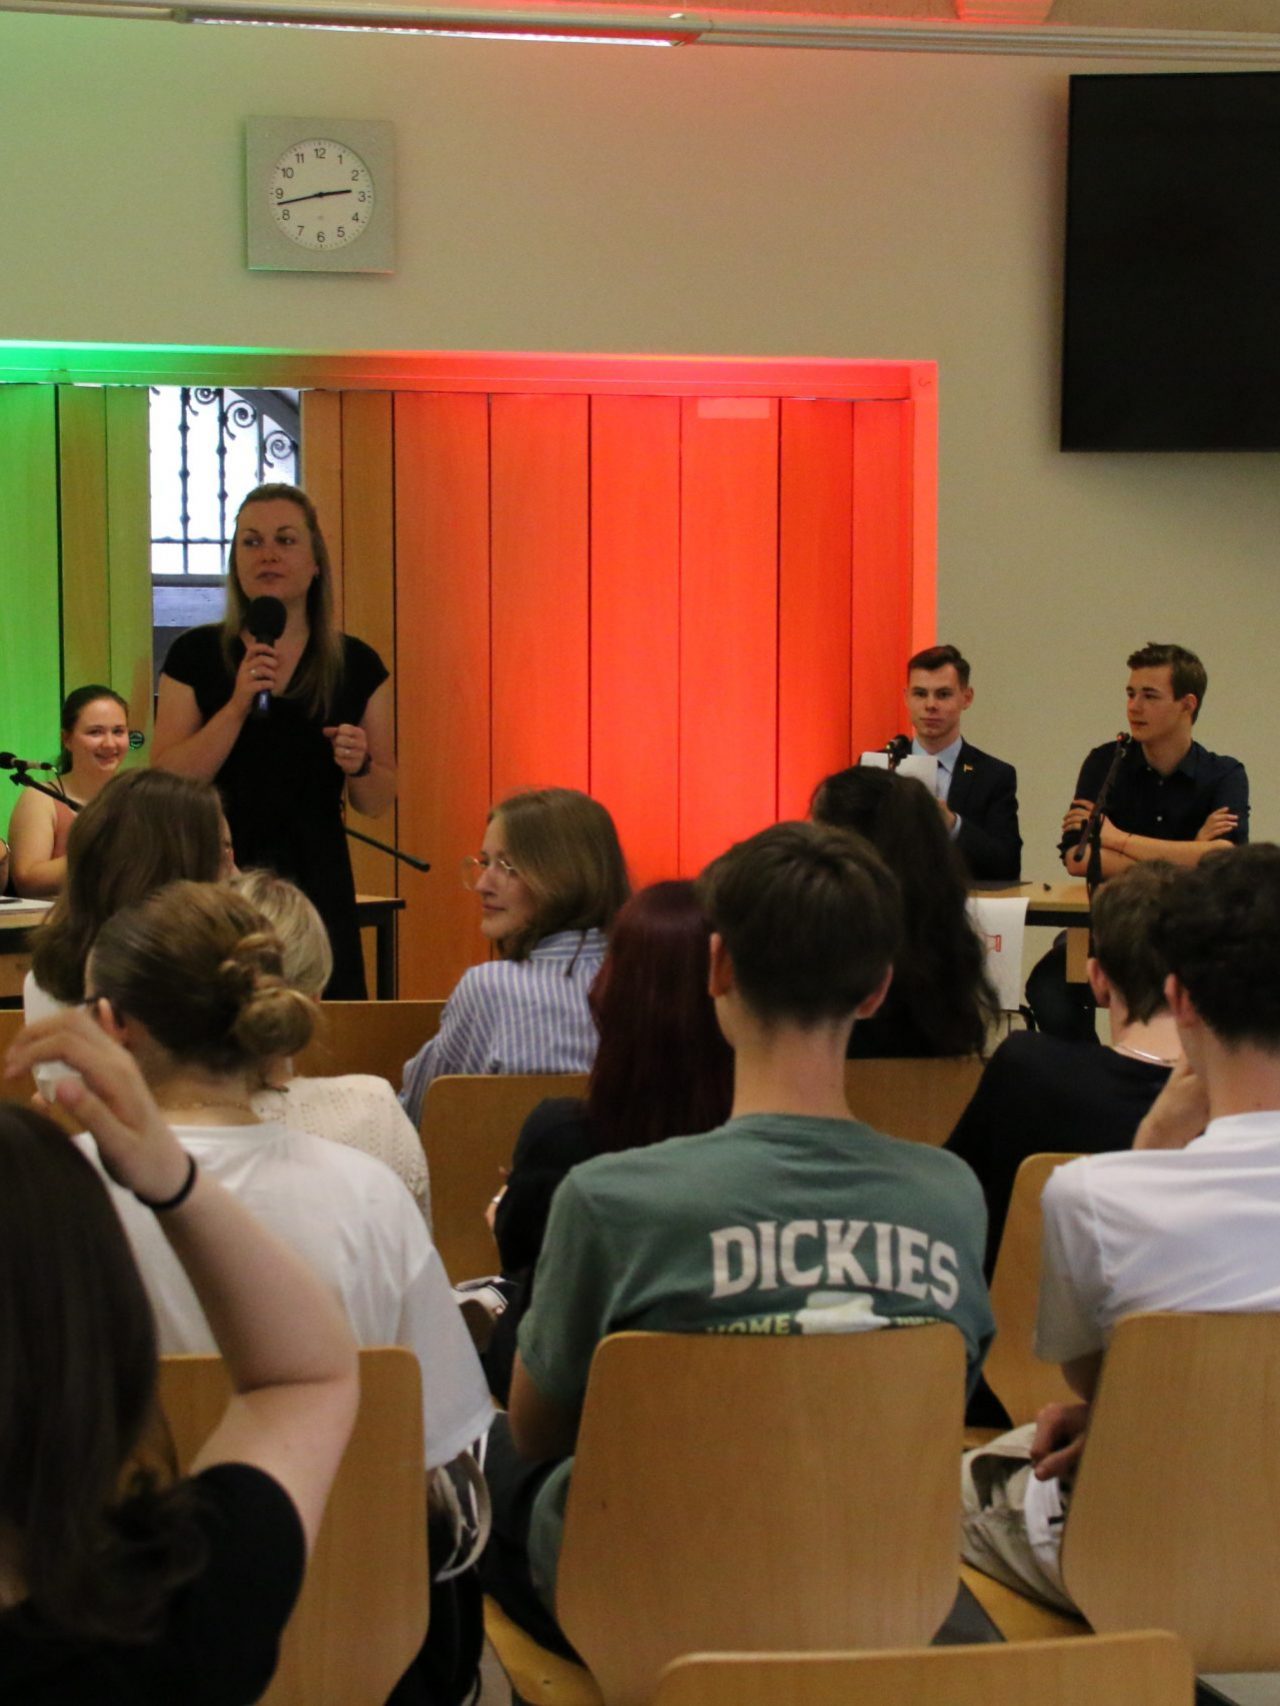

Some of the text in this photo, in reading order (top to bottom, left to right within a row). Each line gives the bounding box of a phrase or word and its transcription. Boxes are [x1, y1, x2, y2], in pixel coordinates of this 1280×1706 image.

[295, 153, 305, 164] 11
[314, 148, 326, 159] 12
[338, 154, 343, 165] 1
[281, 167, 294, 179] 10
[351, 169, 359, 181] 2
[275, 188, 284, 199] 9
[358, 191, 366, 202] 3
[282, 209, 290, 221] 8
[351, 212, 359, 222] 4
[297, 225, 304, 236] 7
[337, 226, 345, 238] 5
[316, 231, 325, 243] 6
[709, 1219, 959, 1310] DICKIES
[706, 1312, 791, 1335] OME
